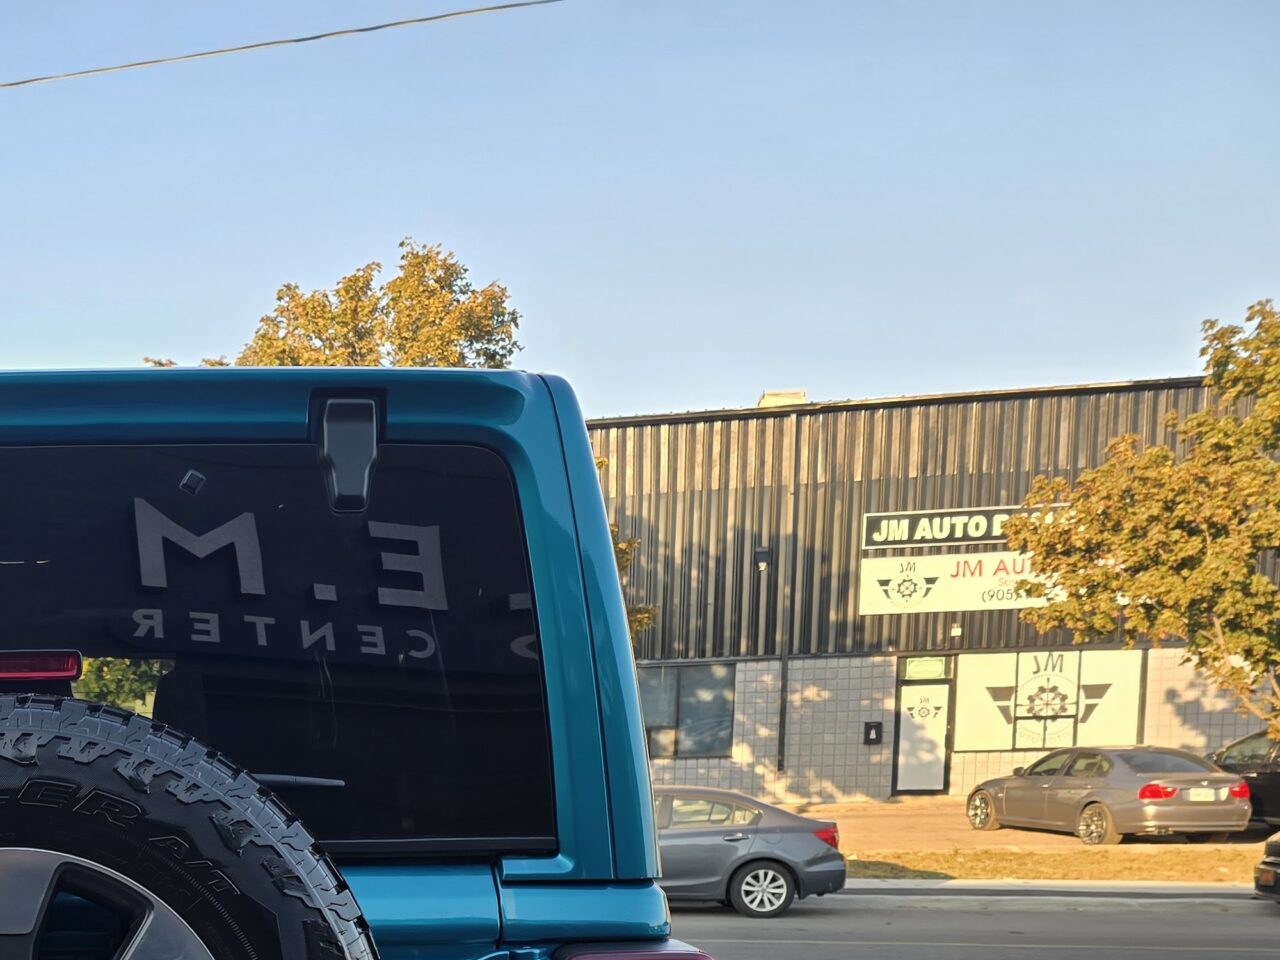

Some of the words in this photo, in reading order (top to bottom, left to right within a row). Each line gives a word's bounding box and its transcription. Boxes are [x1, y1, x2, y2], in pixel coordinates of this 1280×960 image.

[872, 519, 909, 542] JM
[913, 514, 988, 540] AUTO
[950, 559, 983, 579] JM
[1032, 653, 1064, 675] JM
